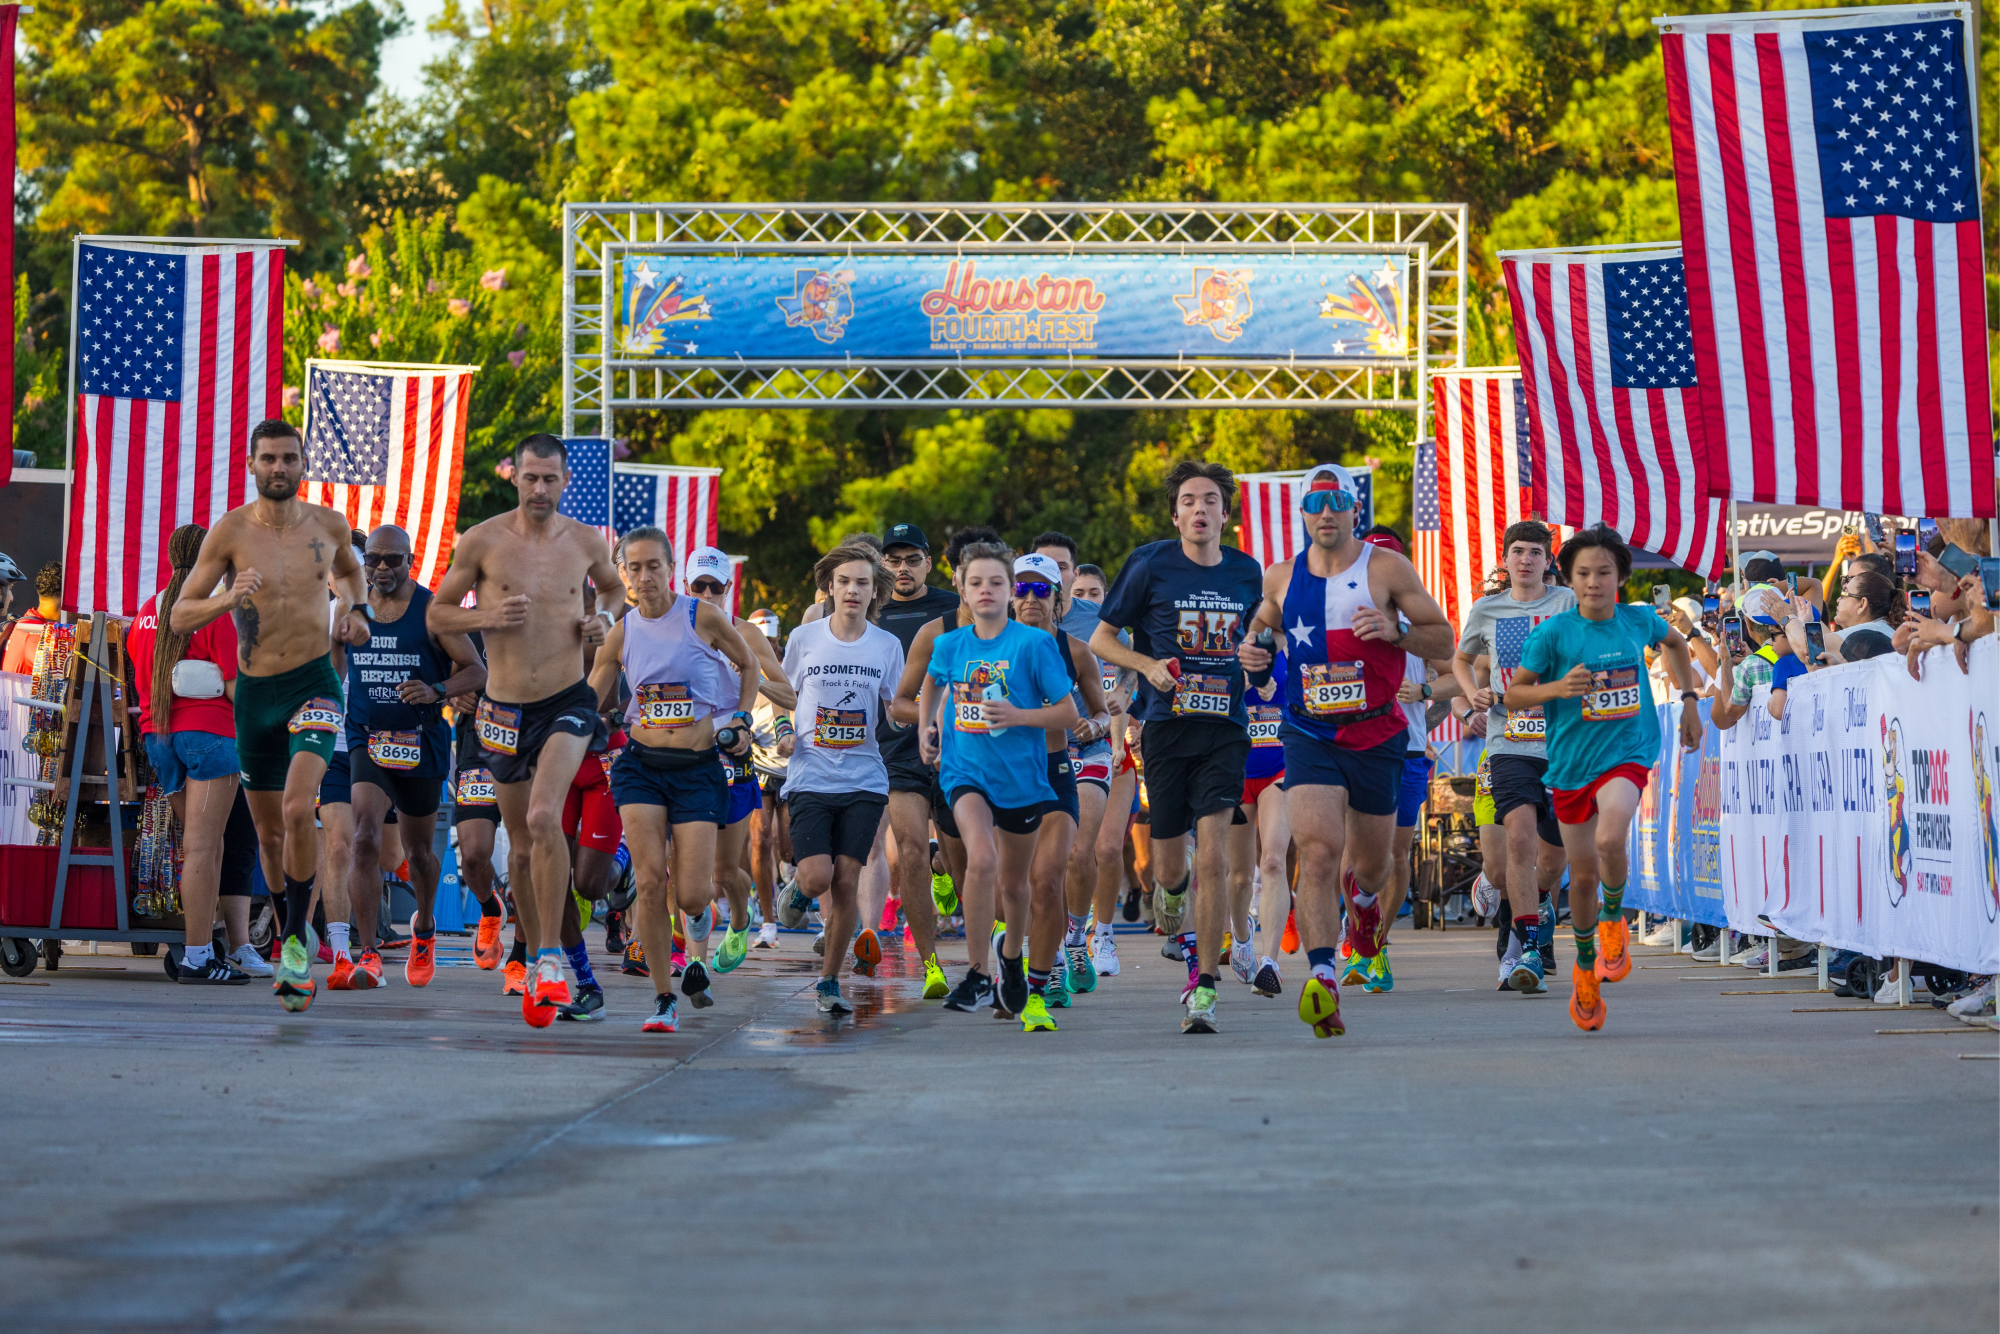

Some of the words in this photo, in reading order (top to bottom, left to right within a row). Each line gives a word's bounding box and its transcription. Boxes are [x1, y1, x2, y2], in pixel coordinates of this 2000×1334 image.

[922, 261, 1105, 315] Houston
[931, 315, 1027, 341] FOURTH
[1038, 315, 1098, 341] FEST
[1174, 600, 1197, 609] SAN
[1199, 601, 1244, 611] ANTONIO
[1177, 610, 1240, 655] 5K
[371, 636, 398, 649] RUN
[352, 653, 420, 667] REPLENISH
[361, 670, 411, 684] REPEAT
[807, 666, 821, 676] DO
[822, 665, 882, 679] SOMETHING
[852, 680, 870, 689] Field
[1319, 684, 1364, 702] 8997
[1189, 694, 1229, 712] 8515
[1599, 688, 1639, 709] 9133
[653, 703, 692, 717] 8787
[302, 711, 342, 729] 8932
[1517, 720, 1545, 732] 905
[483, 723, 516, 746] 8913
[828, 726, 866, 740] 9154
[1249, 724, 1277, 737] 890
[382, 745, 420, 760] 8696
[1746, 759, 1775, 815] ULTRA
[1842, 748, 1876, 813] ULTRA
[470, 785, 496, 797] 854
[142, 797, 154, 838] Houston
[159, 799, 167, 833] FINISHER
[1916, 812, 1952, 852] FIREWORKS
